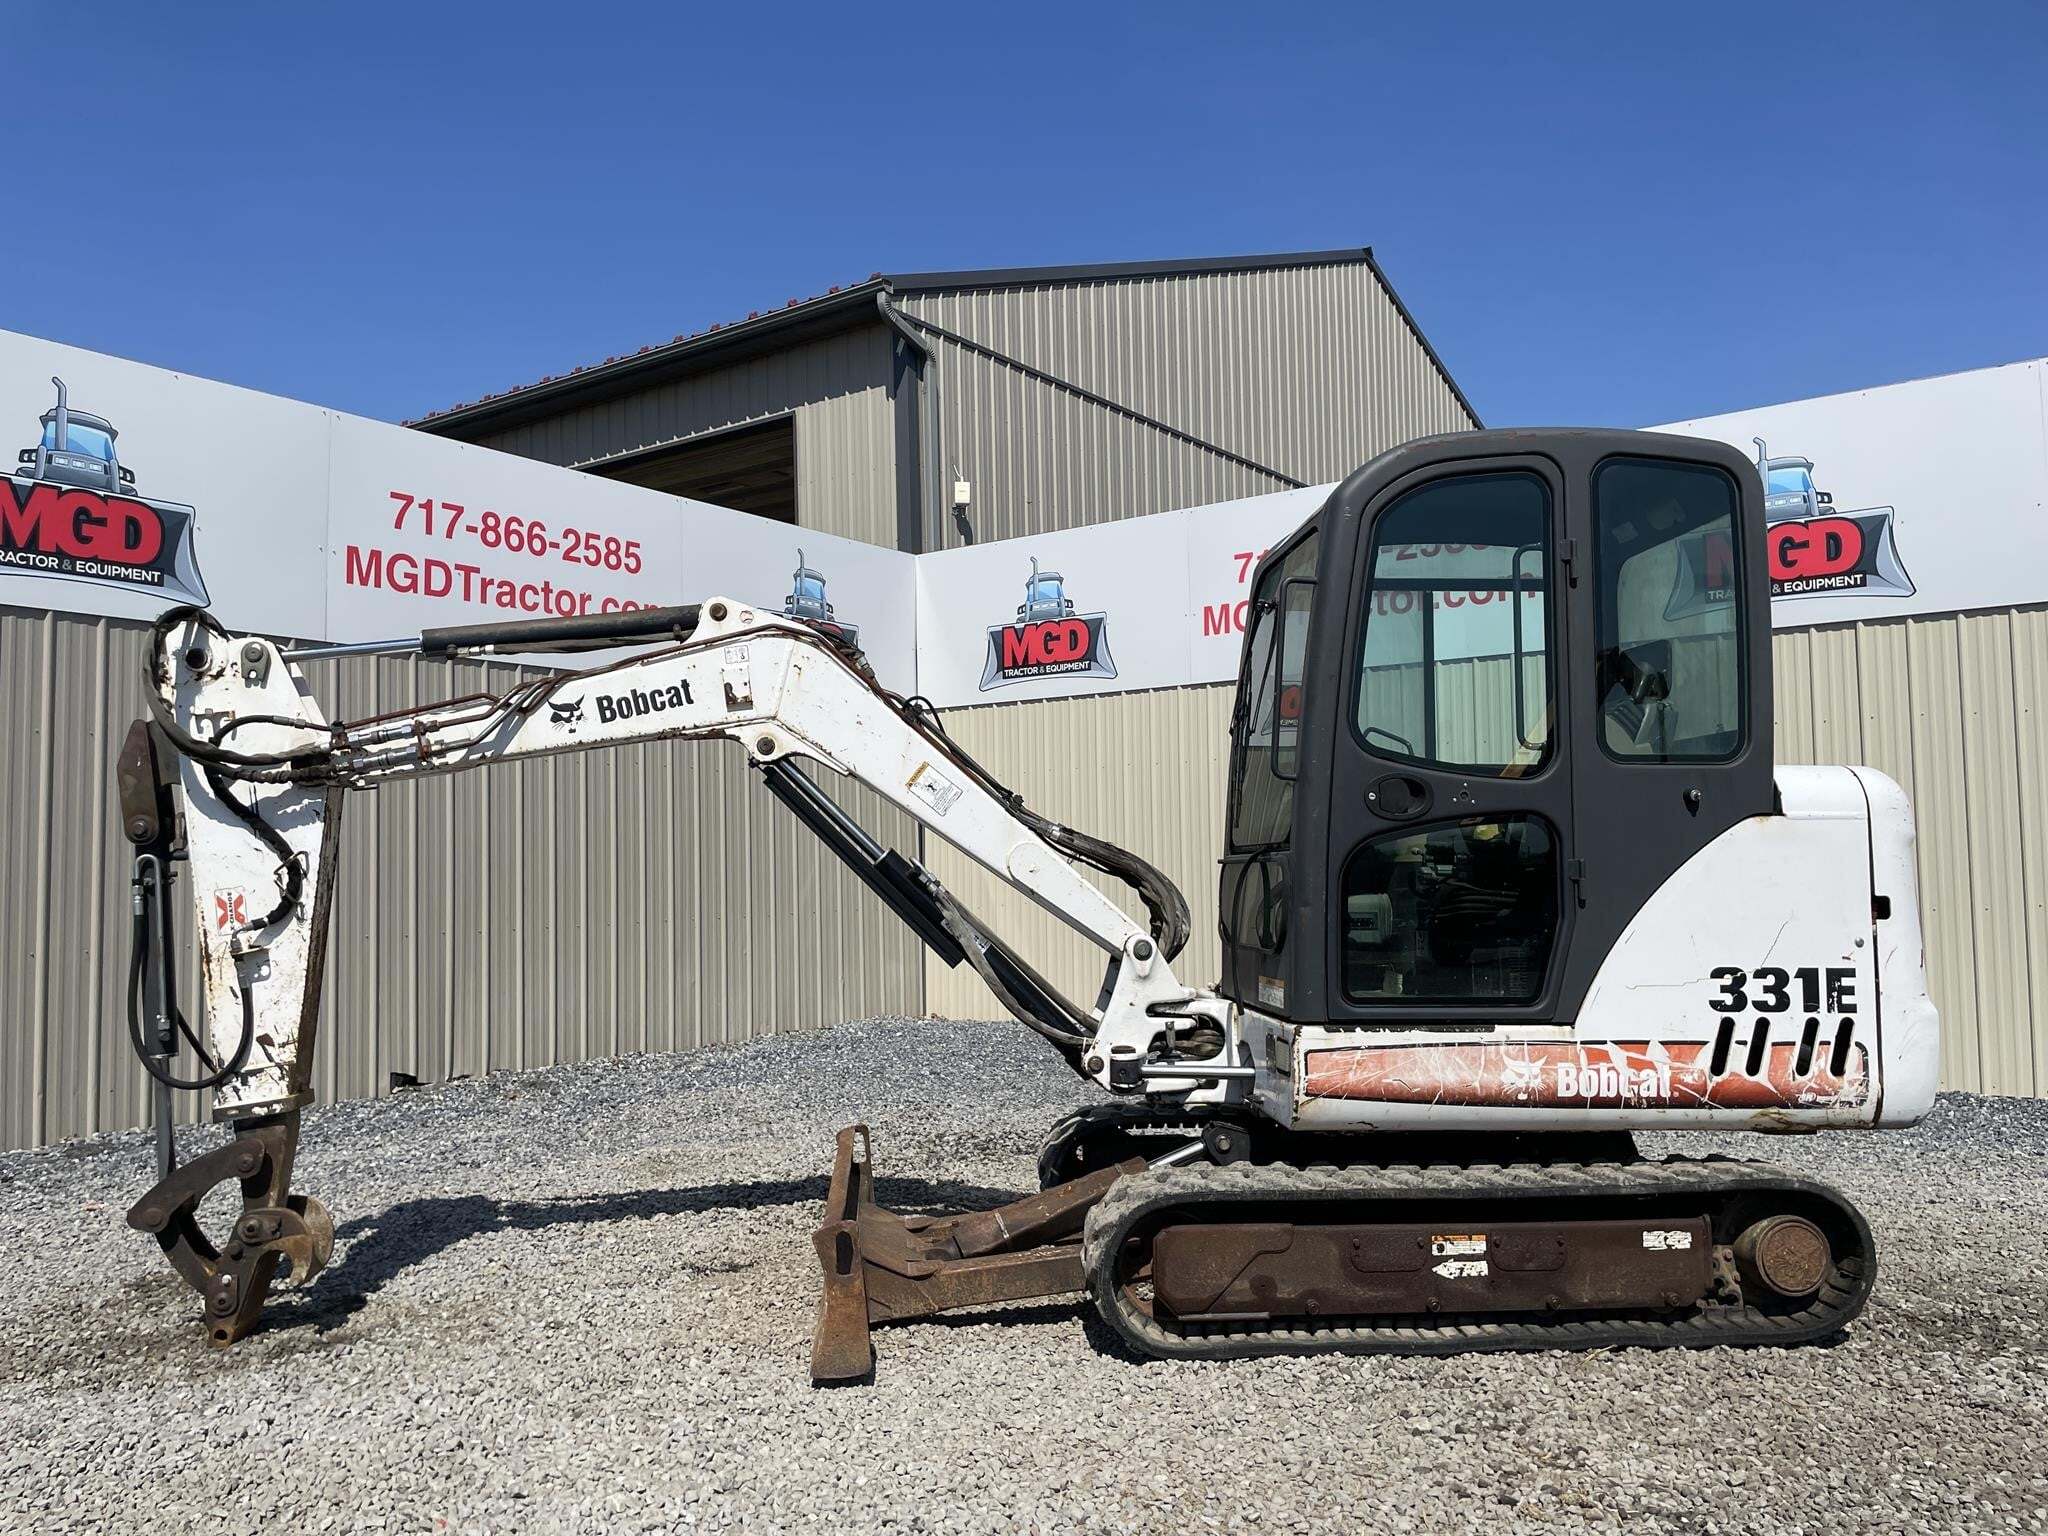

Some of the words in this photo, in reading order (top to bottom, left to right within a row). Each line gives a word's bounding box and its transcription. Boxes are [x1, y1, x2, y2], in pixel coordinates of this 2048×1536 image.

[0, 478, 163, 565] MGD
[389, 491, 642, 574] 717-866-2585
[62, 558, 73, 571] &
[75, 560, 161, 583] EQUIPMENT
[1784, 574, 1864, 593] EQUIPMENT
[1003, 619, 1090, 667] MGD
[1005, 666, 1039, 677] TRACTOR
[1046, 661, 1090, 673] EQUIPMENT
[596, 679, 694, 723] Bobcat
[1707, 967, 1857, 1013] 331E
[1557, 1062, 1672, 1098] Bobcat
